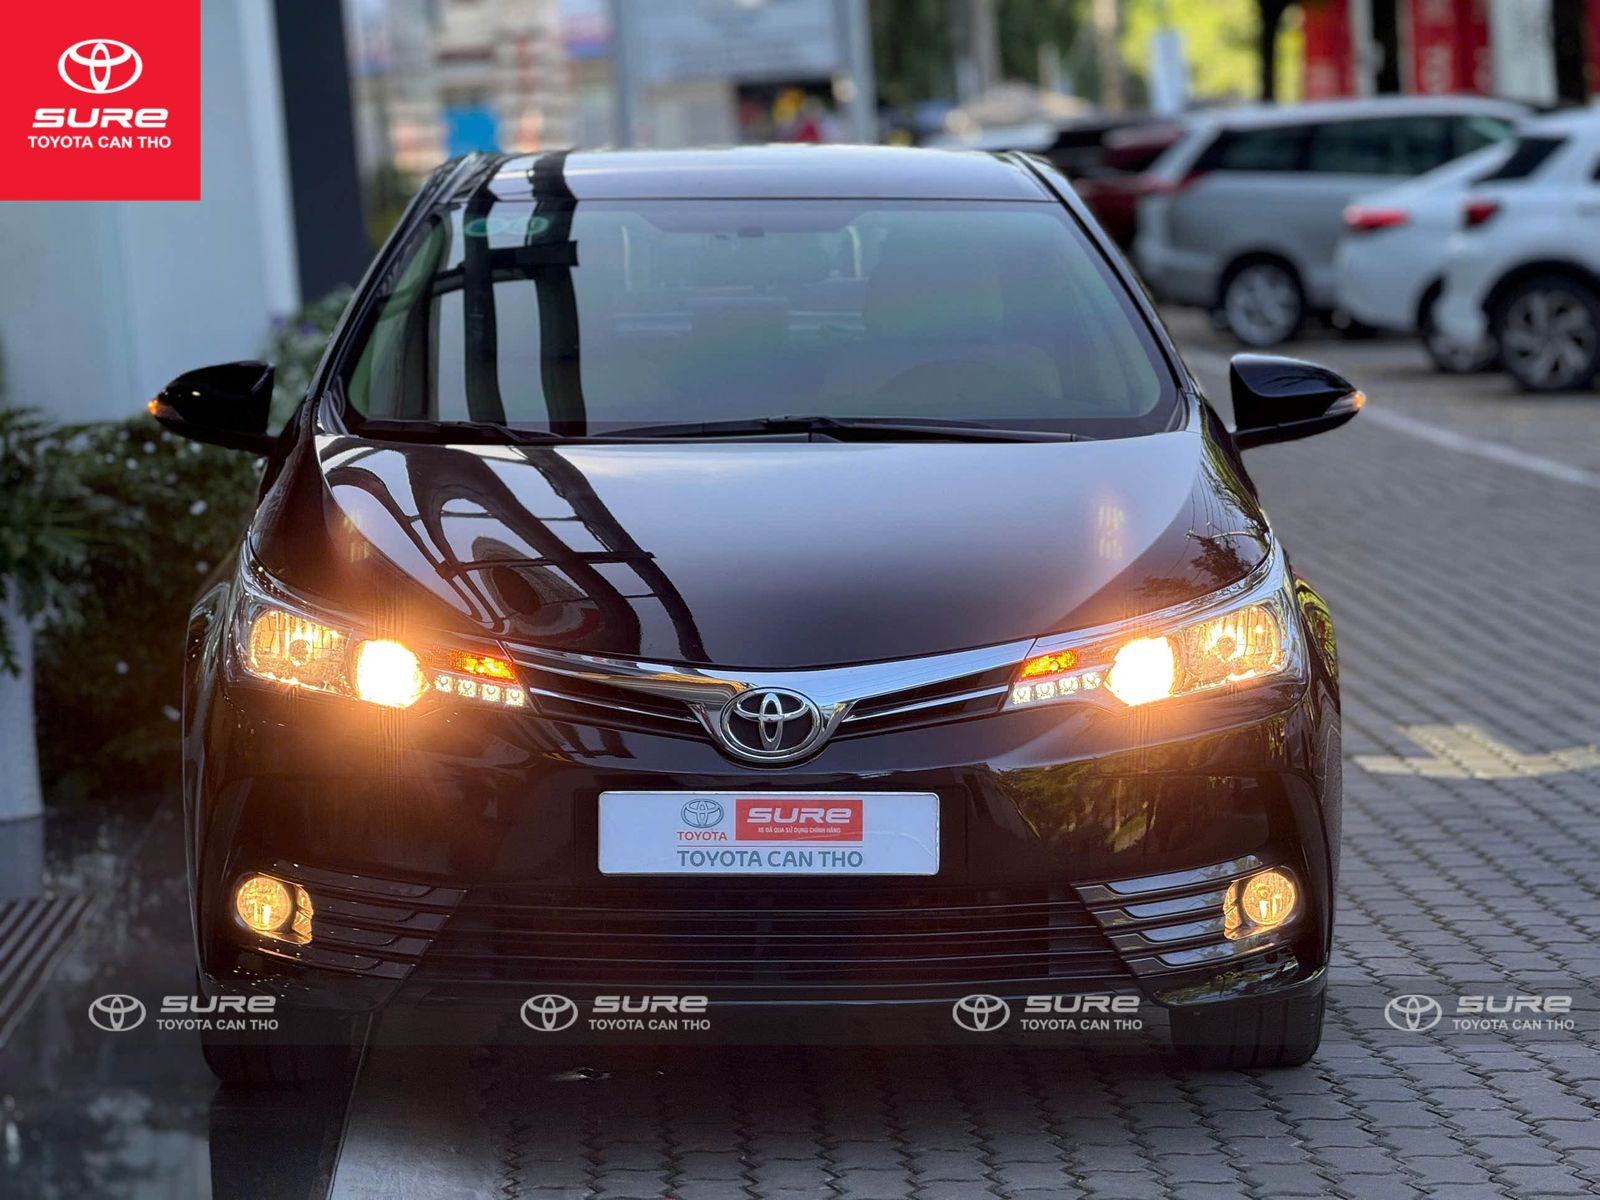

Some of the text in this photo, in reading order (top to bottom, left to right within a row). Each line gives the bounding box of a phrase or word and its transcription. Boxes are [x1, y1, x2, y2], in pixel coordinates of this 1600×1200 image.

[677, 831, 728, 841] TOYOTA
[677, 850, 863, 867] TOYOTA CAN THO
